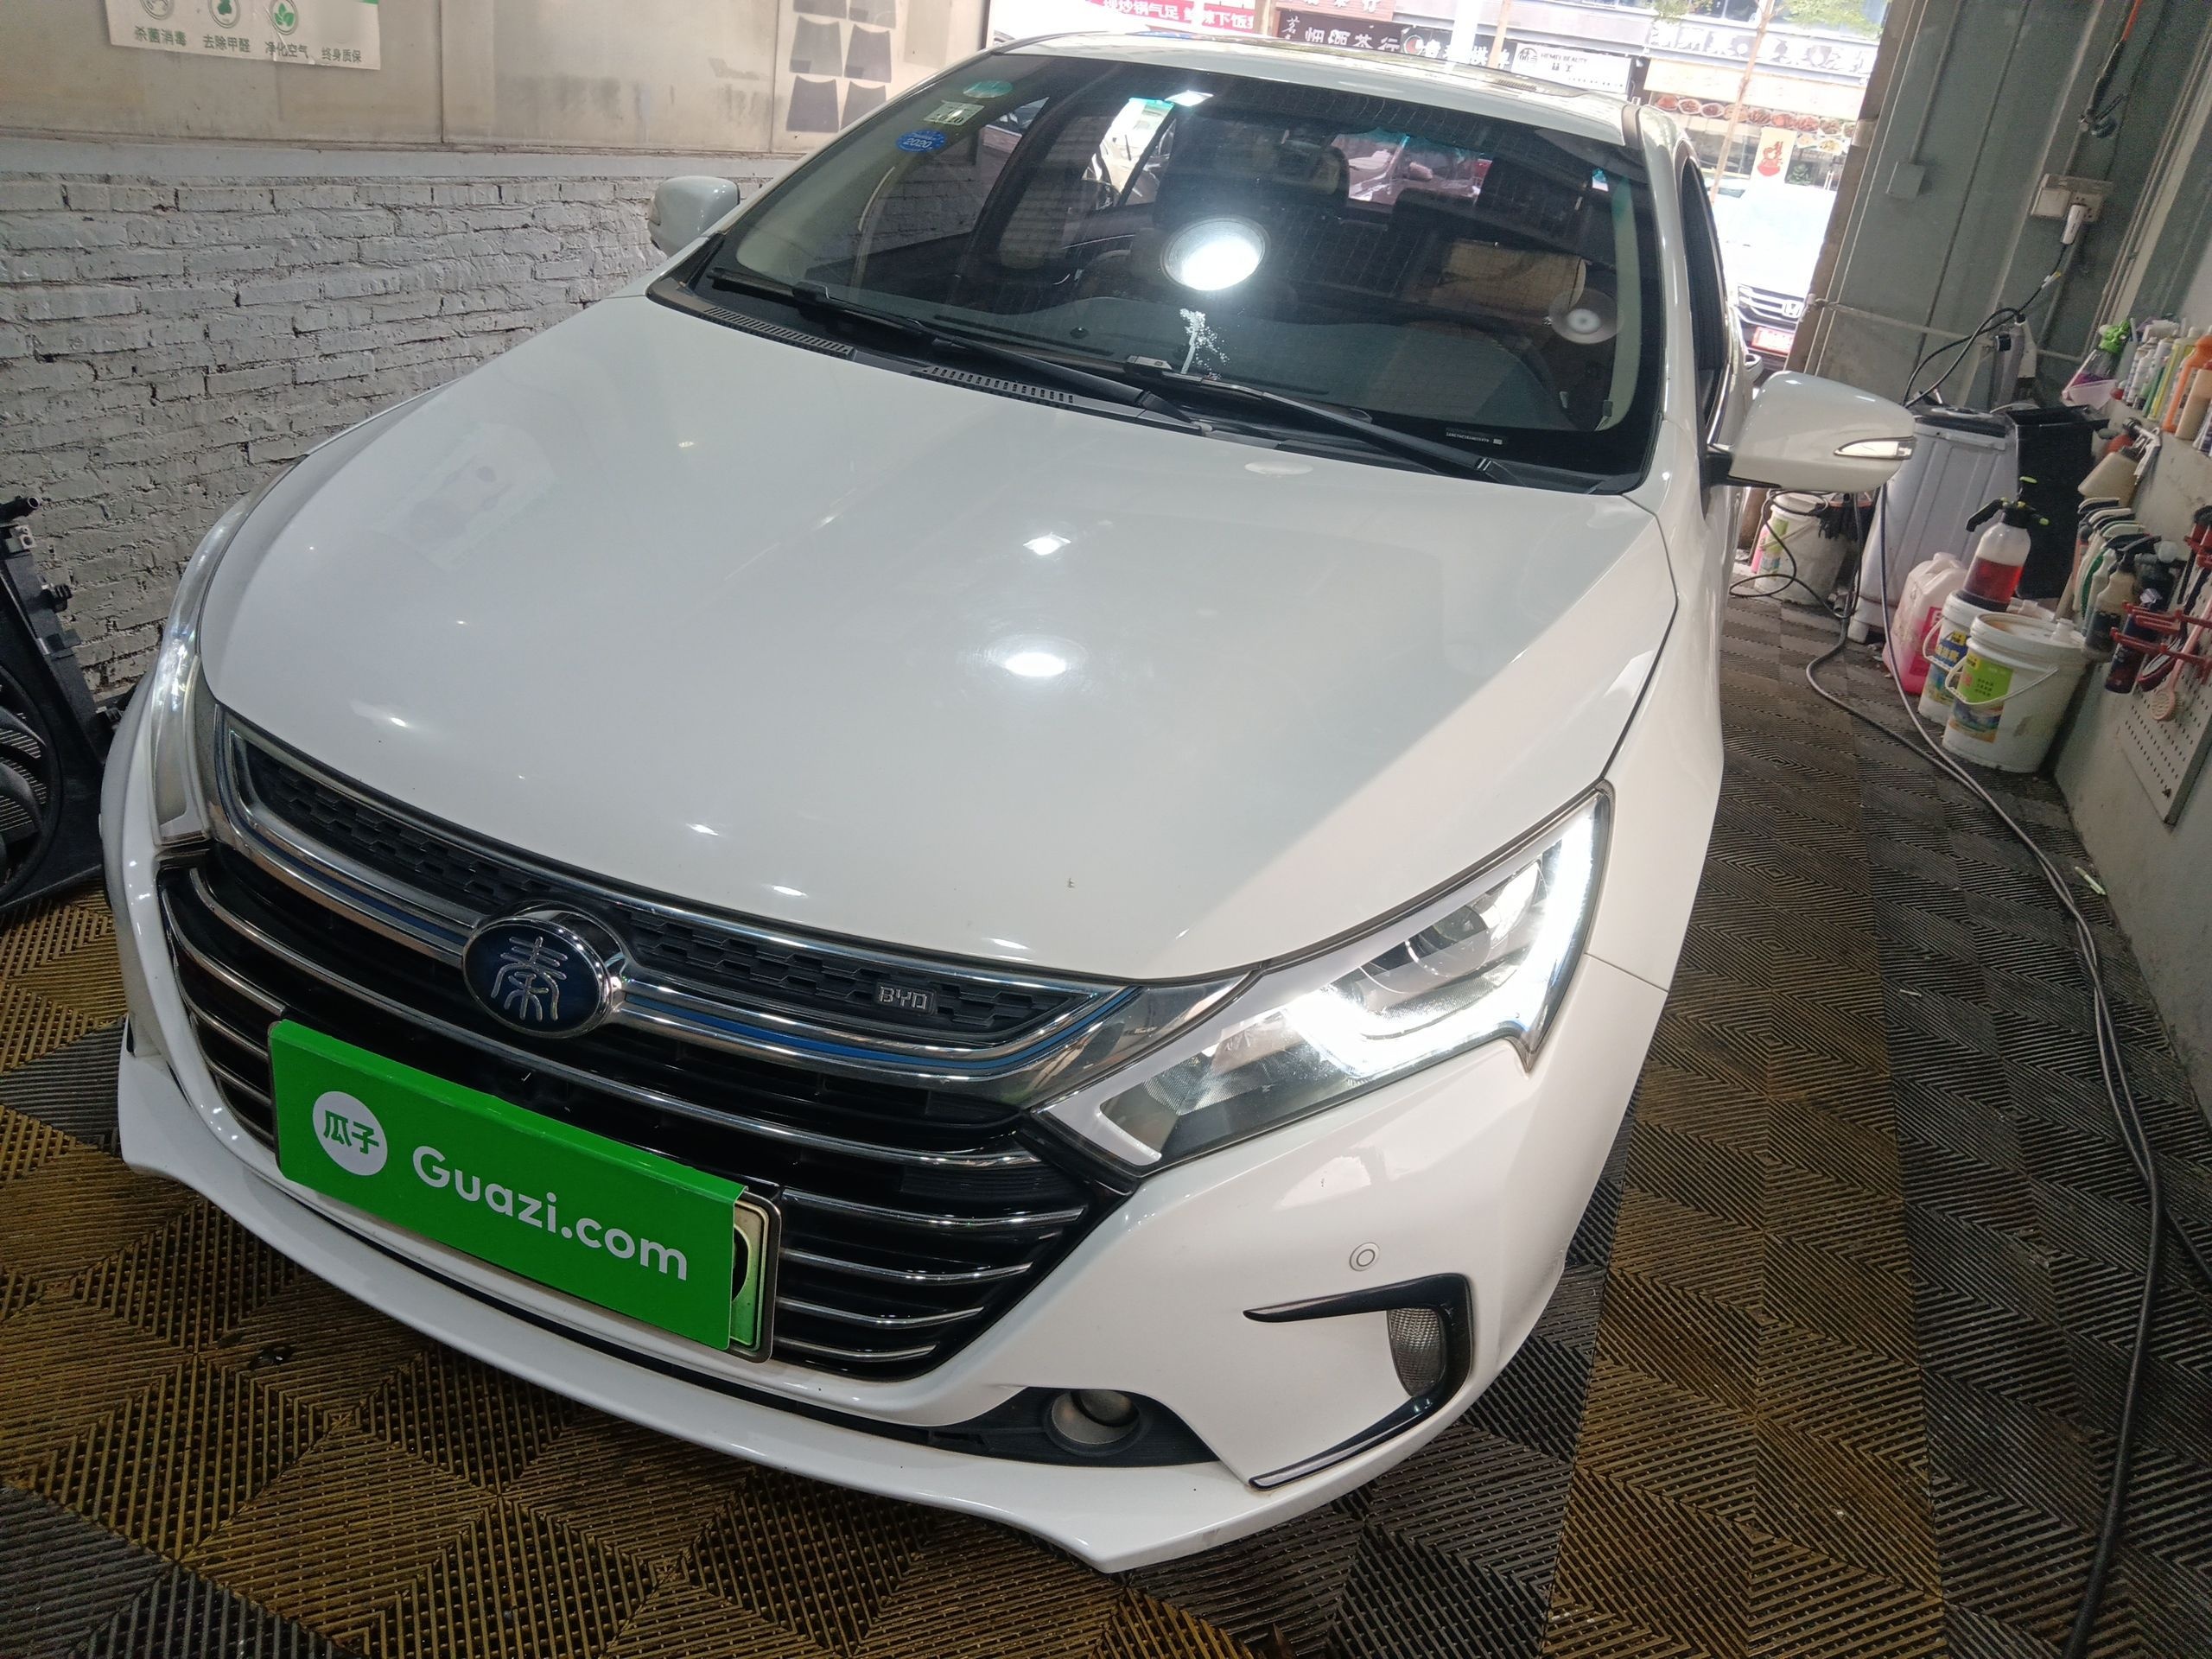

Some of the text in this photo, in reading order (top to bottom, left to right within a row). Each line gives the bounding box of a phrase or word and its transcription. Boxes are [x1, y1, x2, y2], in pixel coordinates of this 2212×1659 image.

[134, 25, 187, 46] 杀菌消毒
[203, 35, 251, 54] 去除甲醛
[264, 41, 309, 60] 净化空气
[321, 48, 362, 63] 终身质保
[903, 138, 933, 149] 2020
[879, 986, 927, 1009] BYD
[322, 1107, 379, 1156] 瓜子
[412, 1144, 688, 1281] Guazi.com
